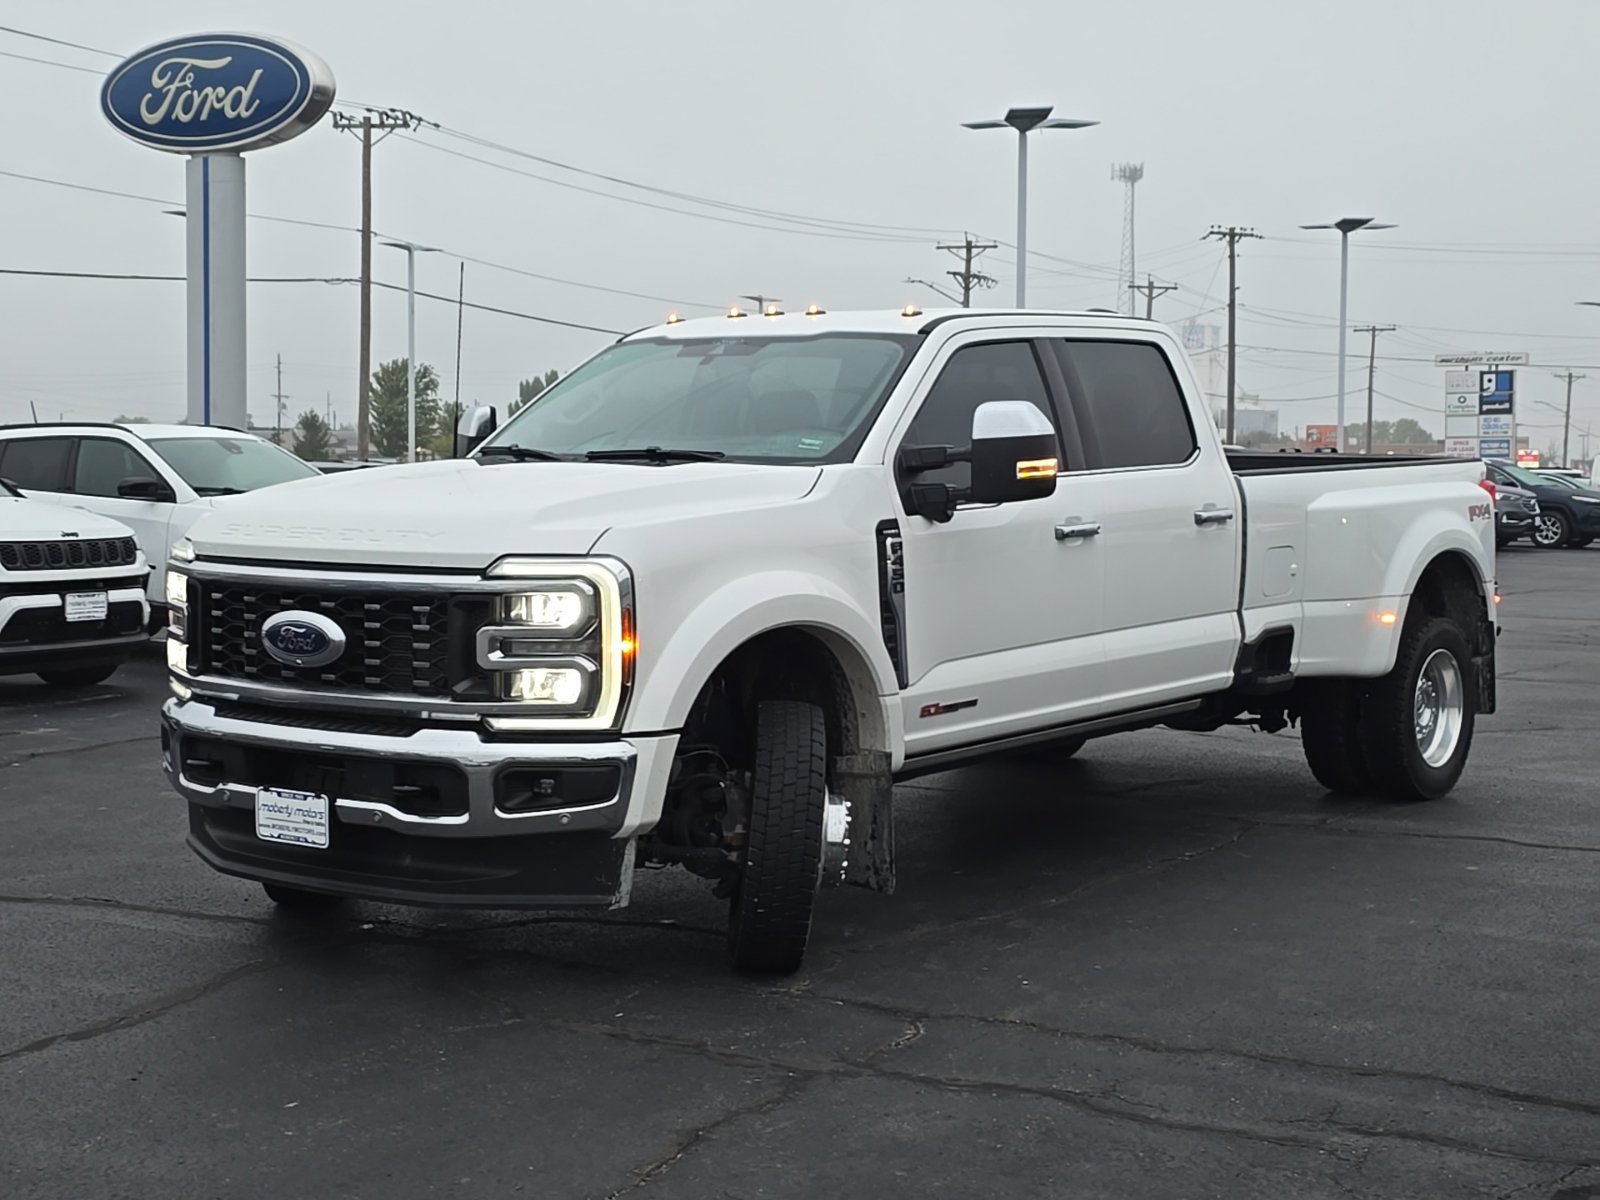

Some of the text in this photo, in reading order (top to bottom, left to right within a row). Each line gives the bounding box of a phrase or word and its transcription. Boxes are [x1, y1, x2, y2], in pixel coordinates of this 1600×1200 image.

[140, 56, 264, 125] Ford
[1486, 354, 1523, 362] center
[221, 523, 448, 543] SUPER DUTY
[277, 625, 316, 651] Ford
[259, 802, 325, 820] moberly motors
